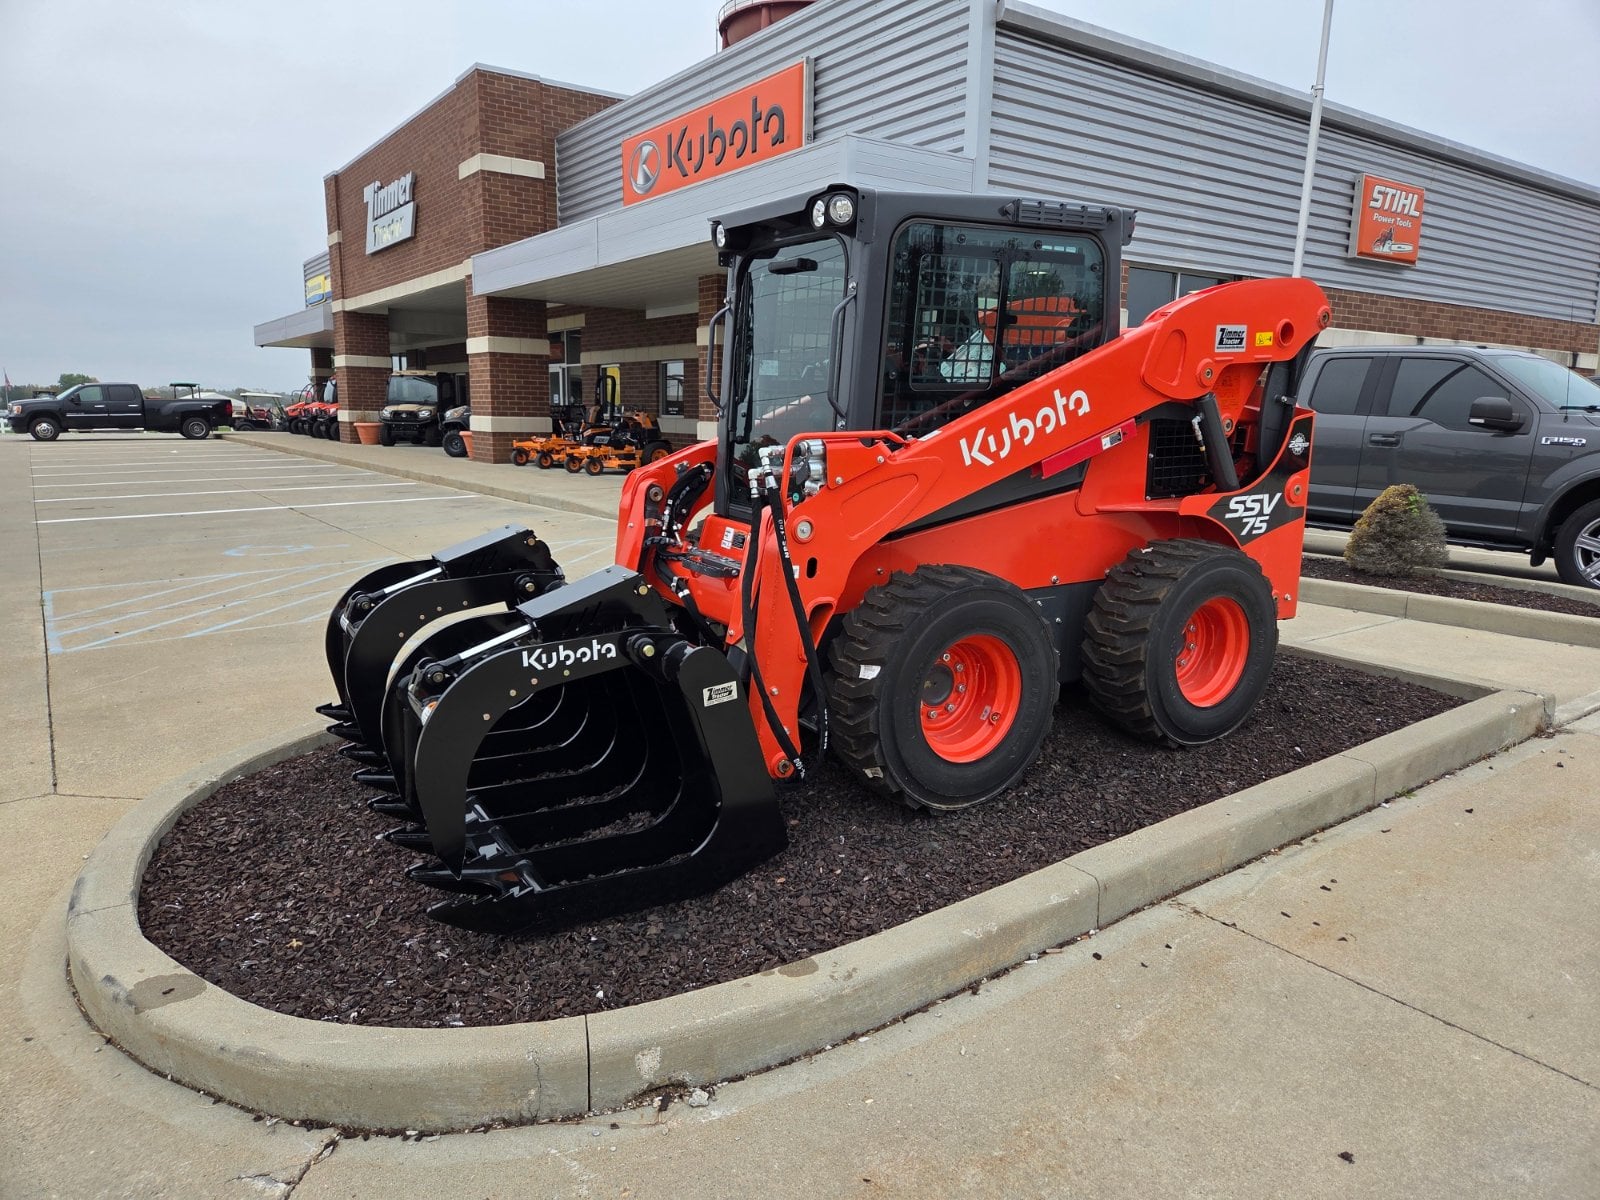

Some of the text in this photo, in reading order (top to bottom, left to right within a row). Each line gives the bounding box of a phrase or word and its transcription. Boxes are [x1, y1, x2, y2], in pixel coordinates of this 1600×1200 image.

[667, 95, 785, 178] Kubota
[363, 170, 414, 221] Zimmer
[1369, 185, 1420, 217] STIHL
[1373, 212, 1412, 228] Power Tools
[1218, 327, 1245, 339] Zimmer
[959, 388, 1091, 467] Kubota
[1224, 492, 1282, 519] SSV
[1240, 515, 1270, 536] 75
[522, 639, 617, 671] Kubota
